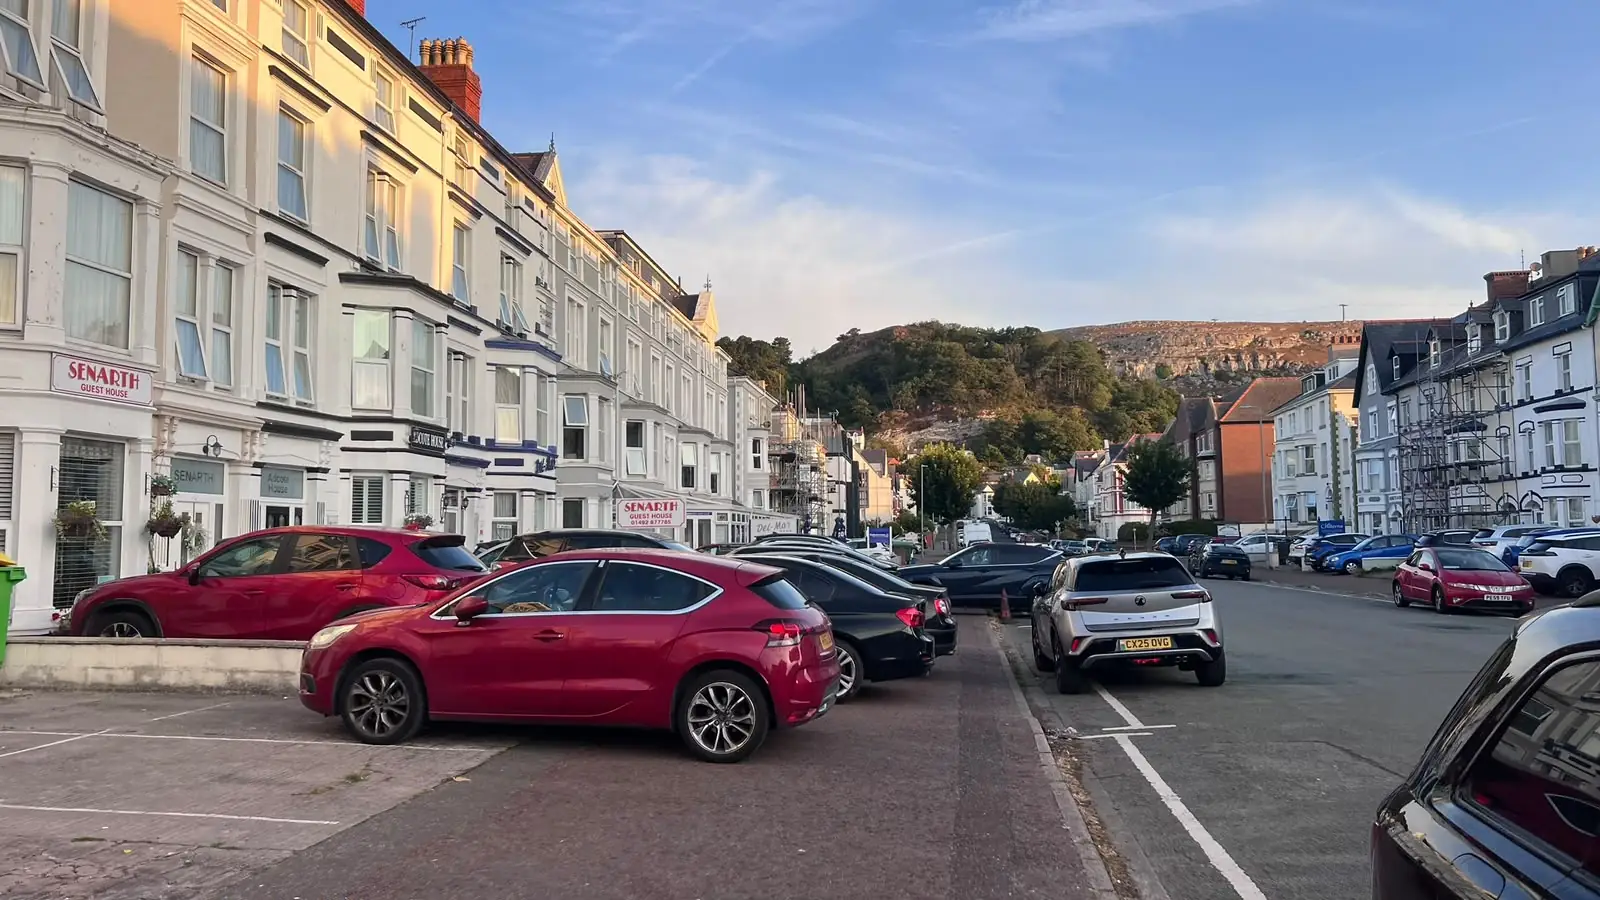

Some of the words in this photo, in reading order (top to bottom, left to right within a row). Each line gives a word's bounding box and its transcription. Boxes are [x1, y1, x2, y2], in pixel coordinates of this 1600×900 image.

[68, 361, 140, 389] SENARTH
[80, 383, 104, 395] GUEST
[105, 387, 129, 398] HOUSE
[412, 430, 430, 446] COTE
[174, 469, 214, 482] SENARTH
[624, 501, 678, 512] SENARTH
[1125, 640, 1149, 648] CX25
[1151, 638, 1169, 647] OVG
